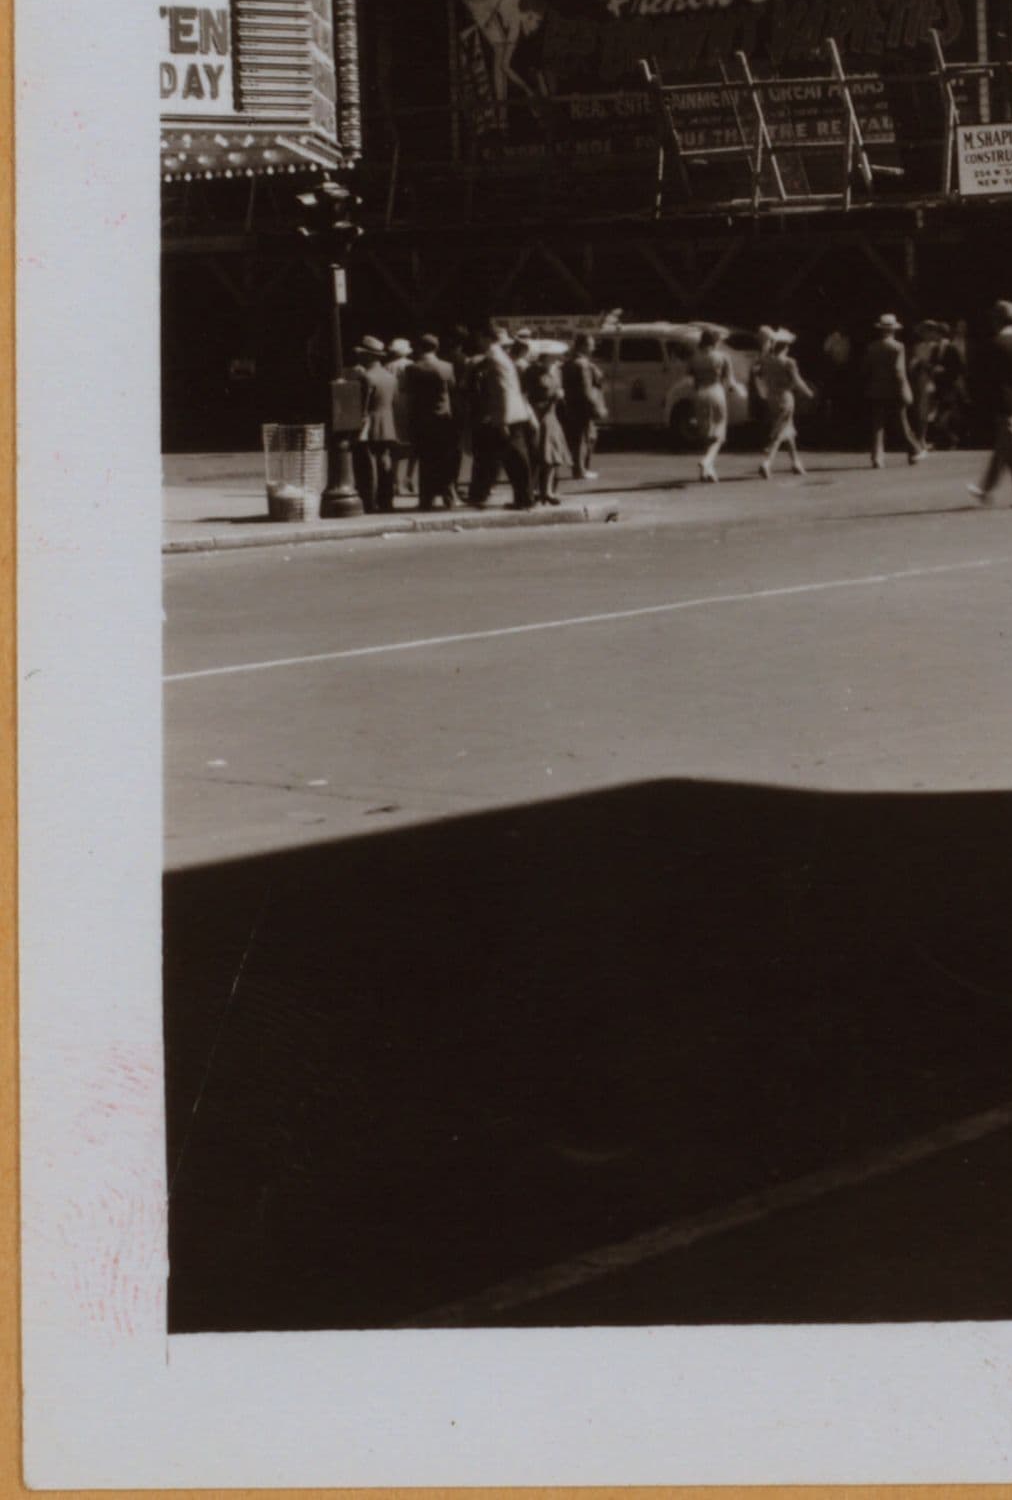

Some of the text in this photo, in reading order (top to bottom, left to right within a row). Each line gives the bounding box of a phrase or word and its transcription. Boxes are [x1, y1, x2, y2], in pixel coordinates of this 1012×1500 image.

[158, 6, 227, 56] EN
[158, 62, 223, 100] DAY
[977, 178, 999, 187] NEW
